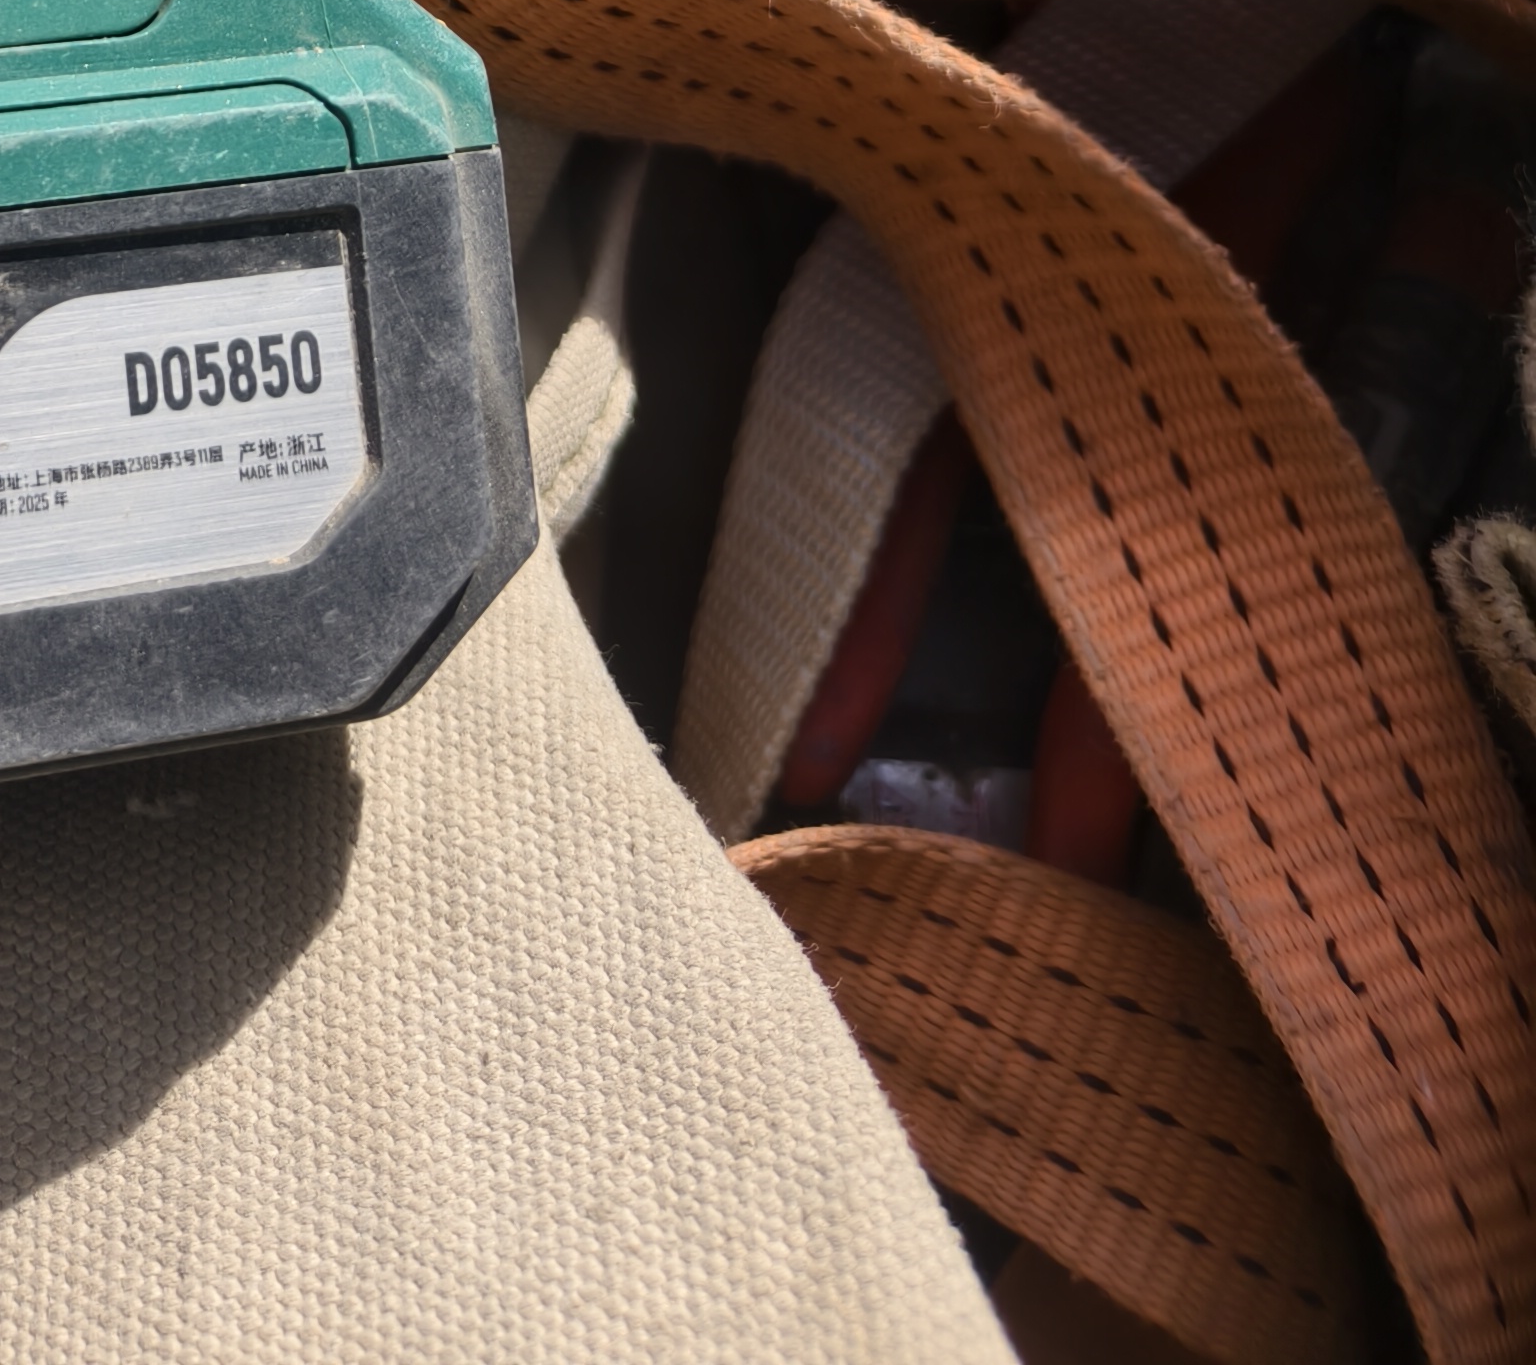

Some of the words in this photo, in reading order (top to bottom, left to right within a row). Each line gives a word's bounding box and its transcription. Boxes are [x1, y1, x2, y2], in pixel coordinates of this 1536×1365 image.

[238, 463, 273, 482] MADE
[276, 462, 289, 477] IN
[292, 457, 329, 475] CHINA
